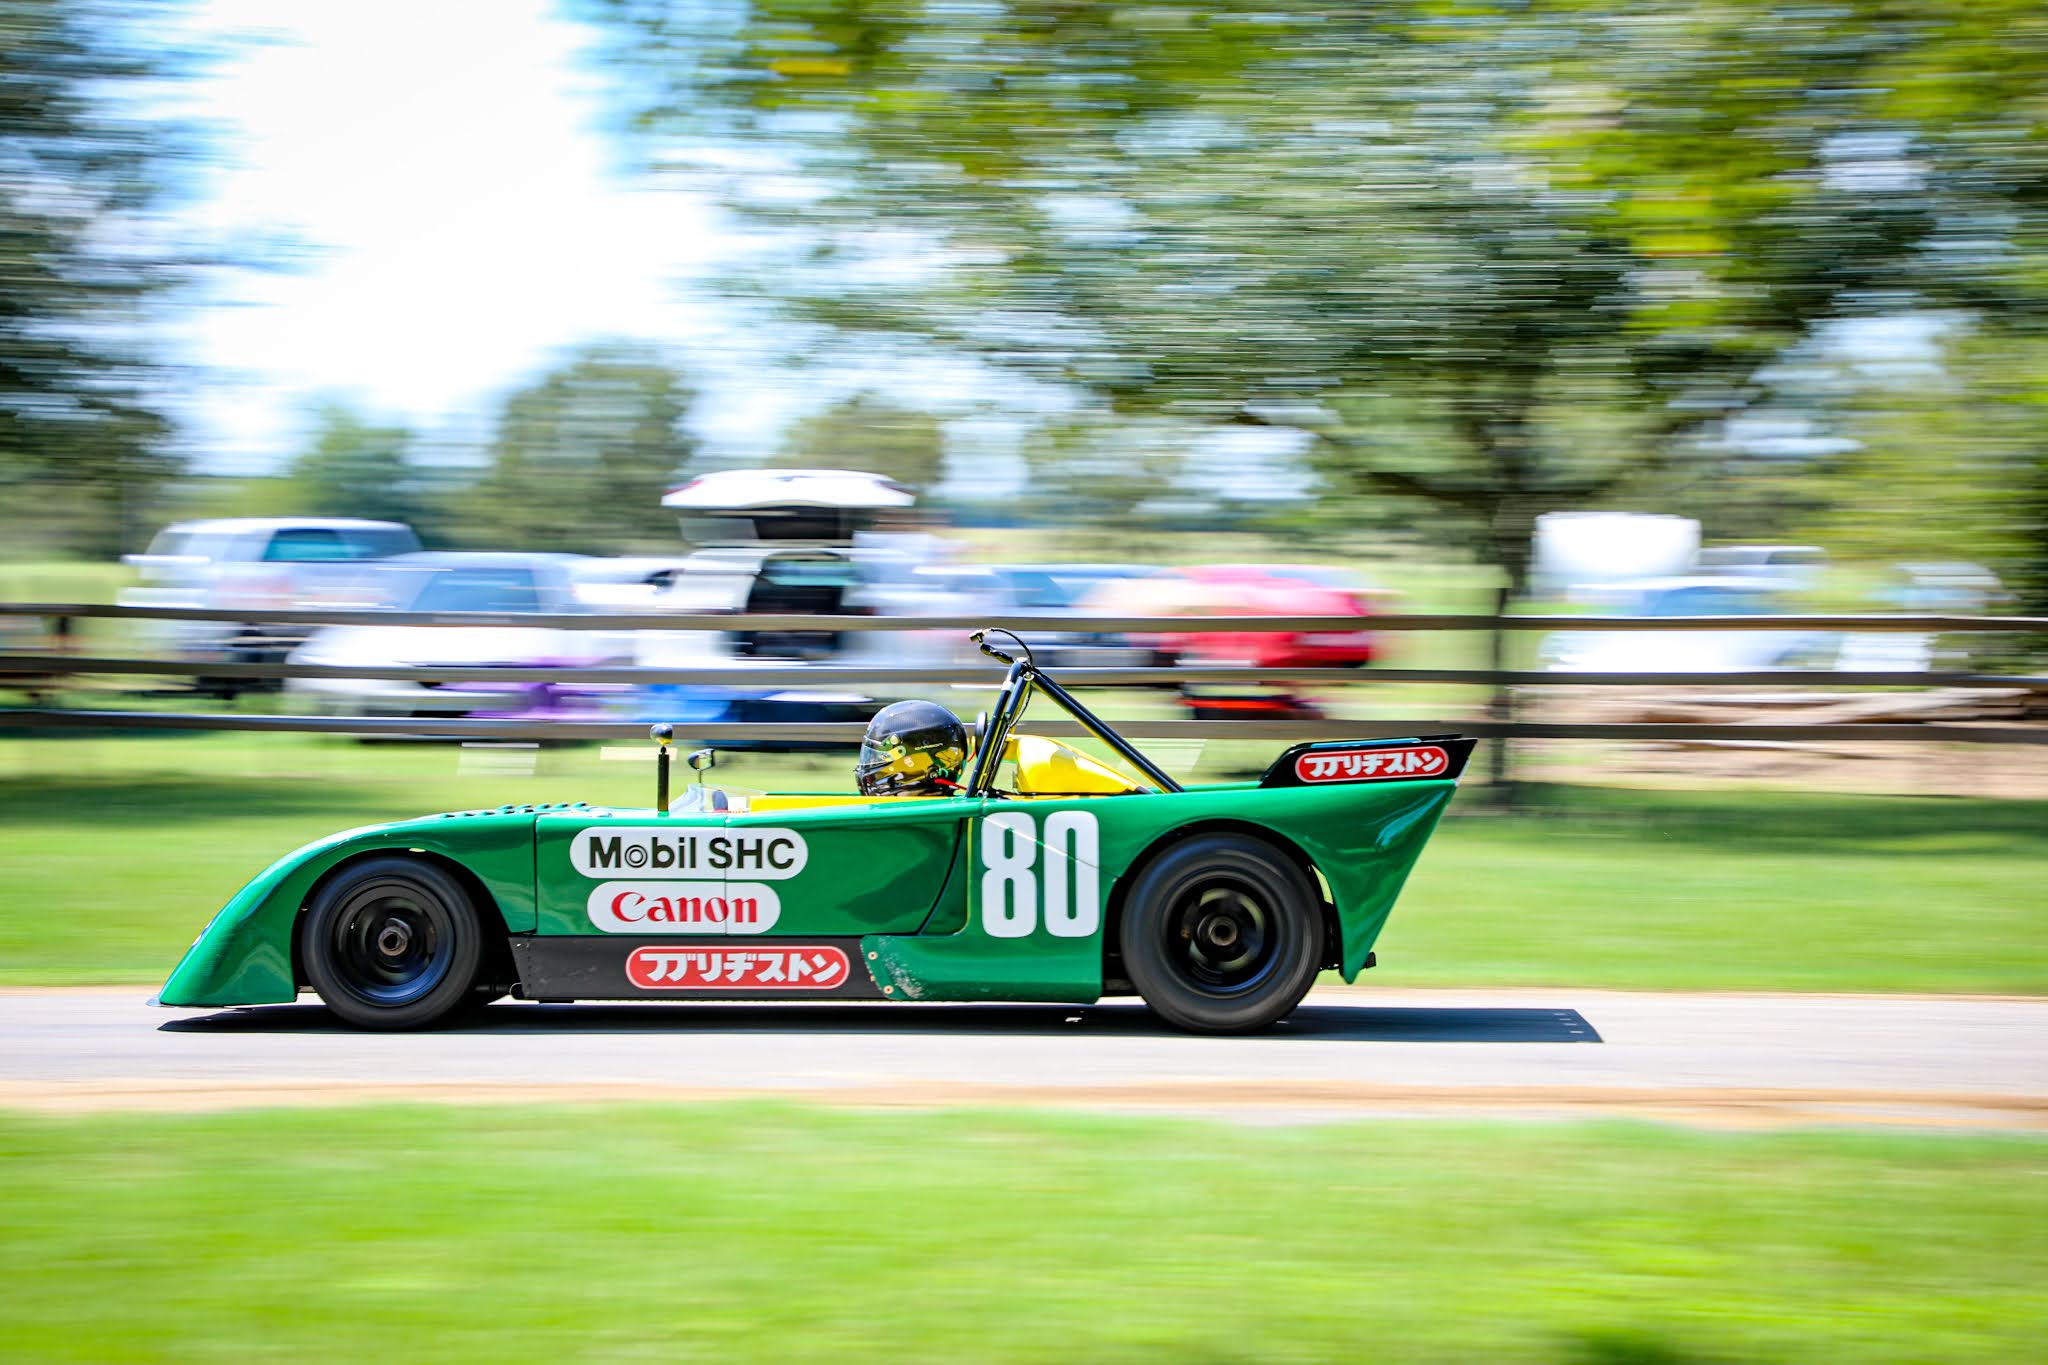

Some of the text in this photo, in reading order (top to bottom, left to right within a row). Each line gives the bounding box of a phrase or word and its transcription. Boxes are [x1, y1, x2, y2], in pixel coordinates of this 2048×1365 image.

[589, 837, 795, 869] Mobil SHC
[981, 810, 1100, 938] 80
[611, 891, 758, 923] Canon
